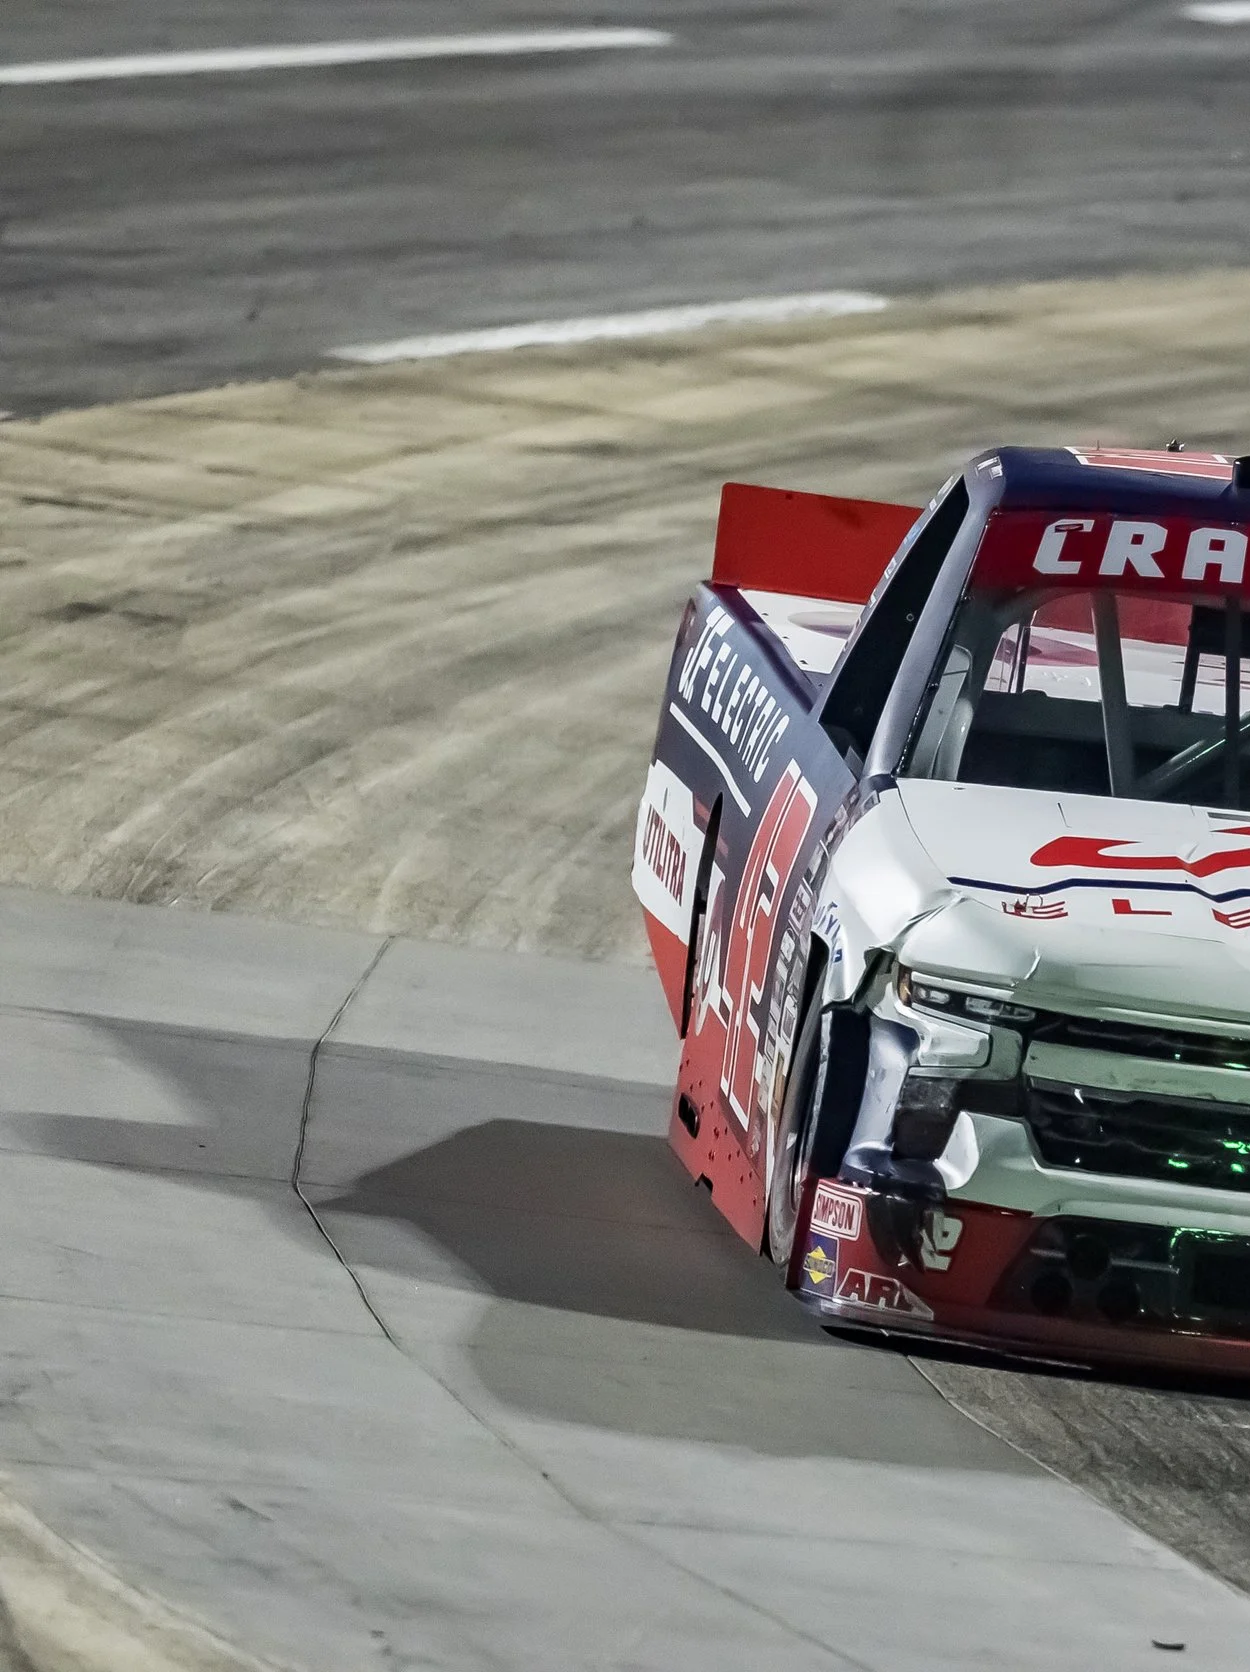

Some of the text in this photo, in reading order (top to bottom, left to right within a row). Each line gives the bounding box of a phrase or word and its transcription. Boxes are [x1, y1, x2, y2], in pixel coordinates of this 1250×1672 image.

[701, 641, 790, 784] ELECTRIC
[642, 801, 687, 908] UTILITRA
[814, 1193, 856, 1232] SIMPSON
